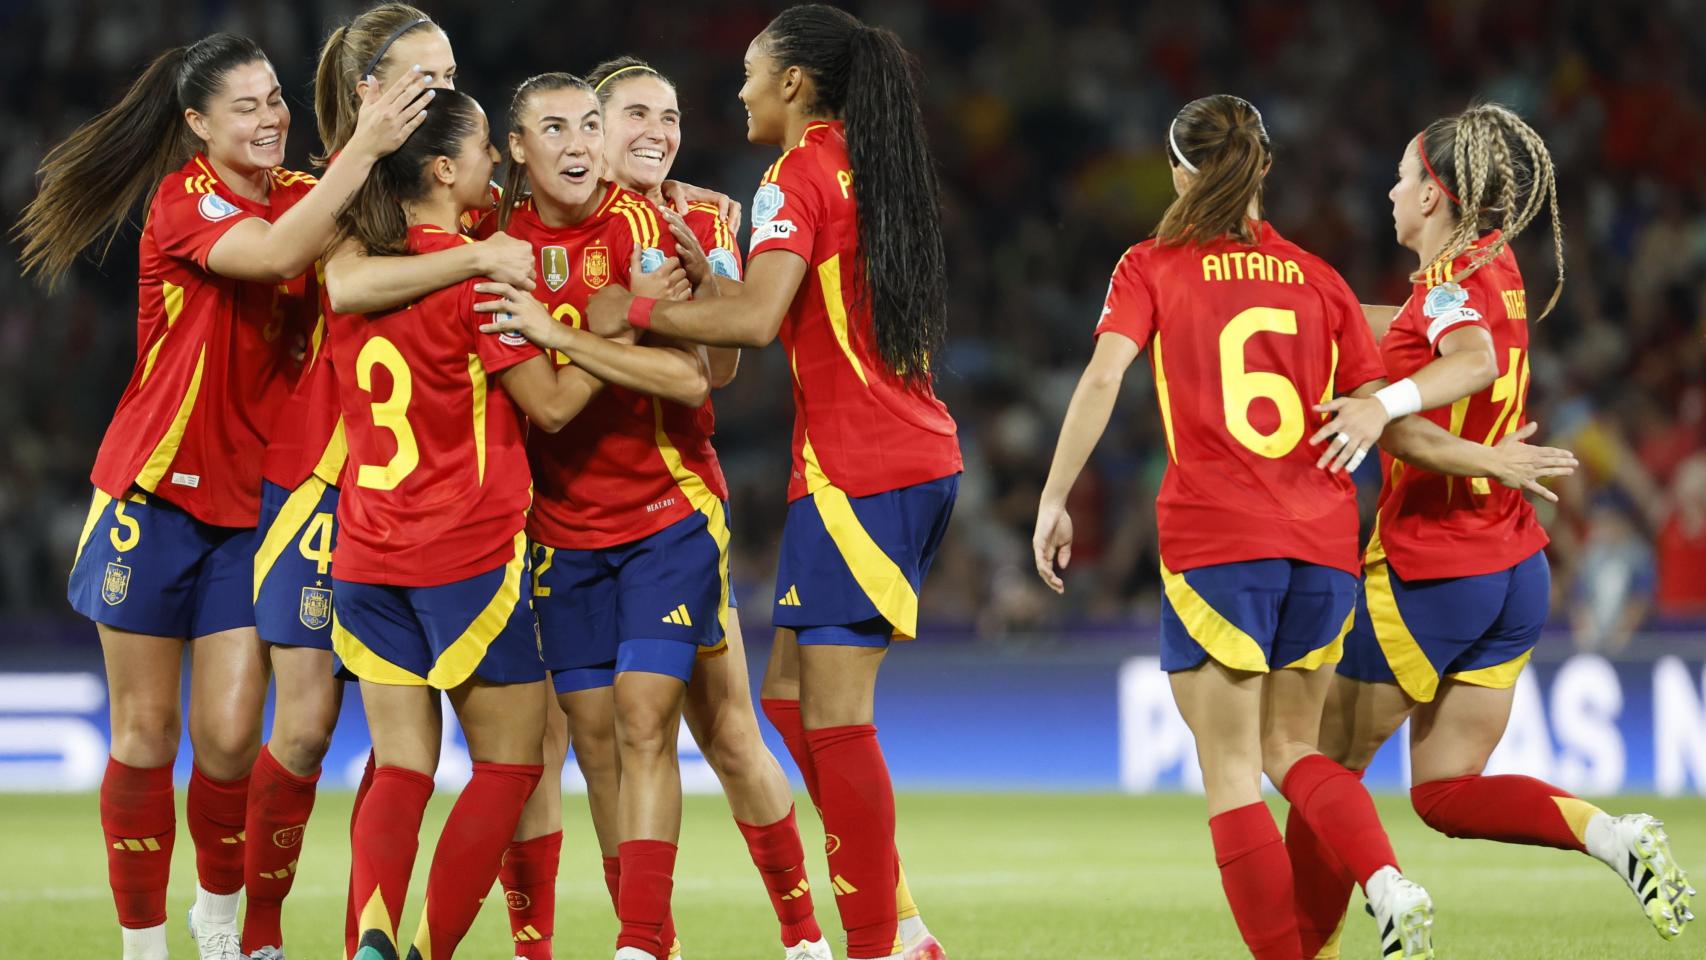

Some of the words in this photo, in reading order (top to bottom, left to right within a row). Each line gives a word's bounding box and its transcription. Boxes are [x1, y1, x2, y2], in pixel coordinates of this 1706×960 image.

[1202, 252, 1305, 285] AITANA
[355, 335, 419, 491] 3
[1219, 306, 1305, 459] 6
[109, 493, 147, 553] 5
[646, 498, 675, 512] HEAT.RDY
[298, 512, 333, 575] 4
